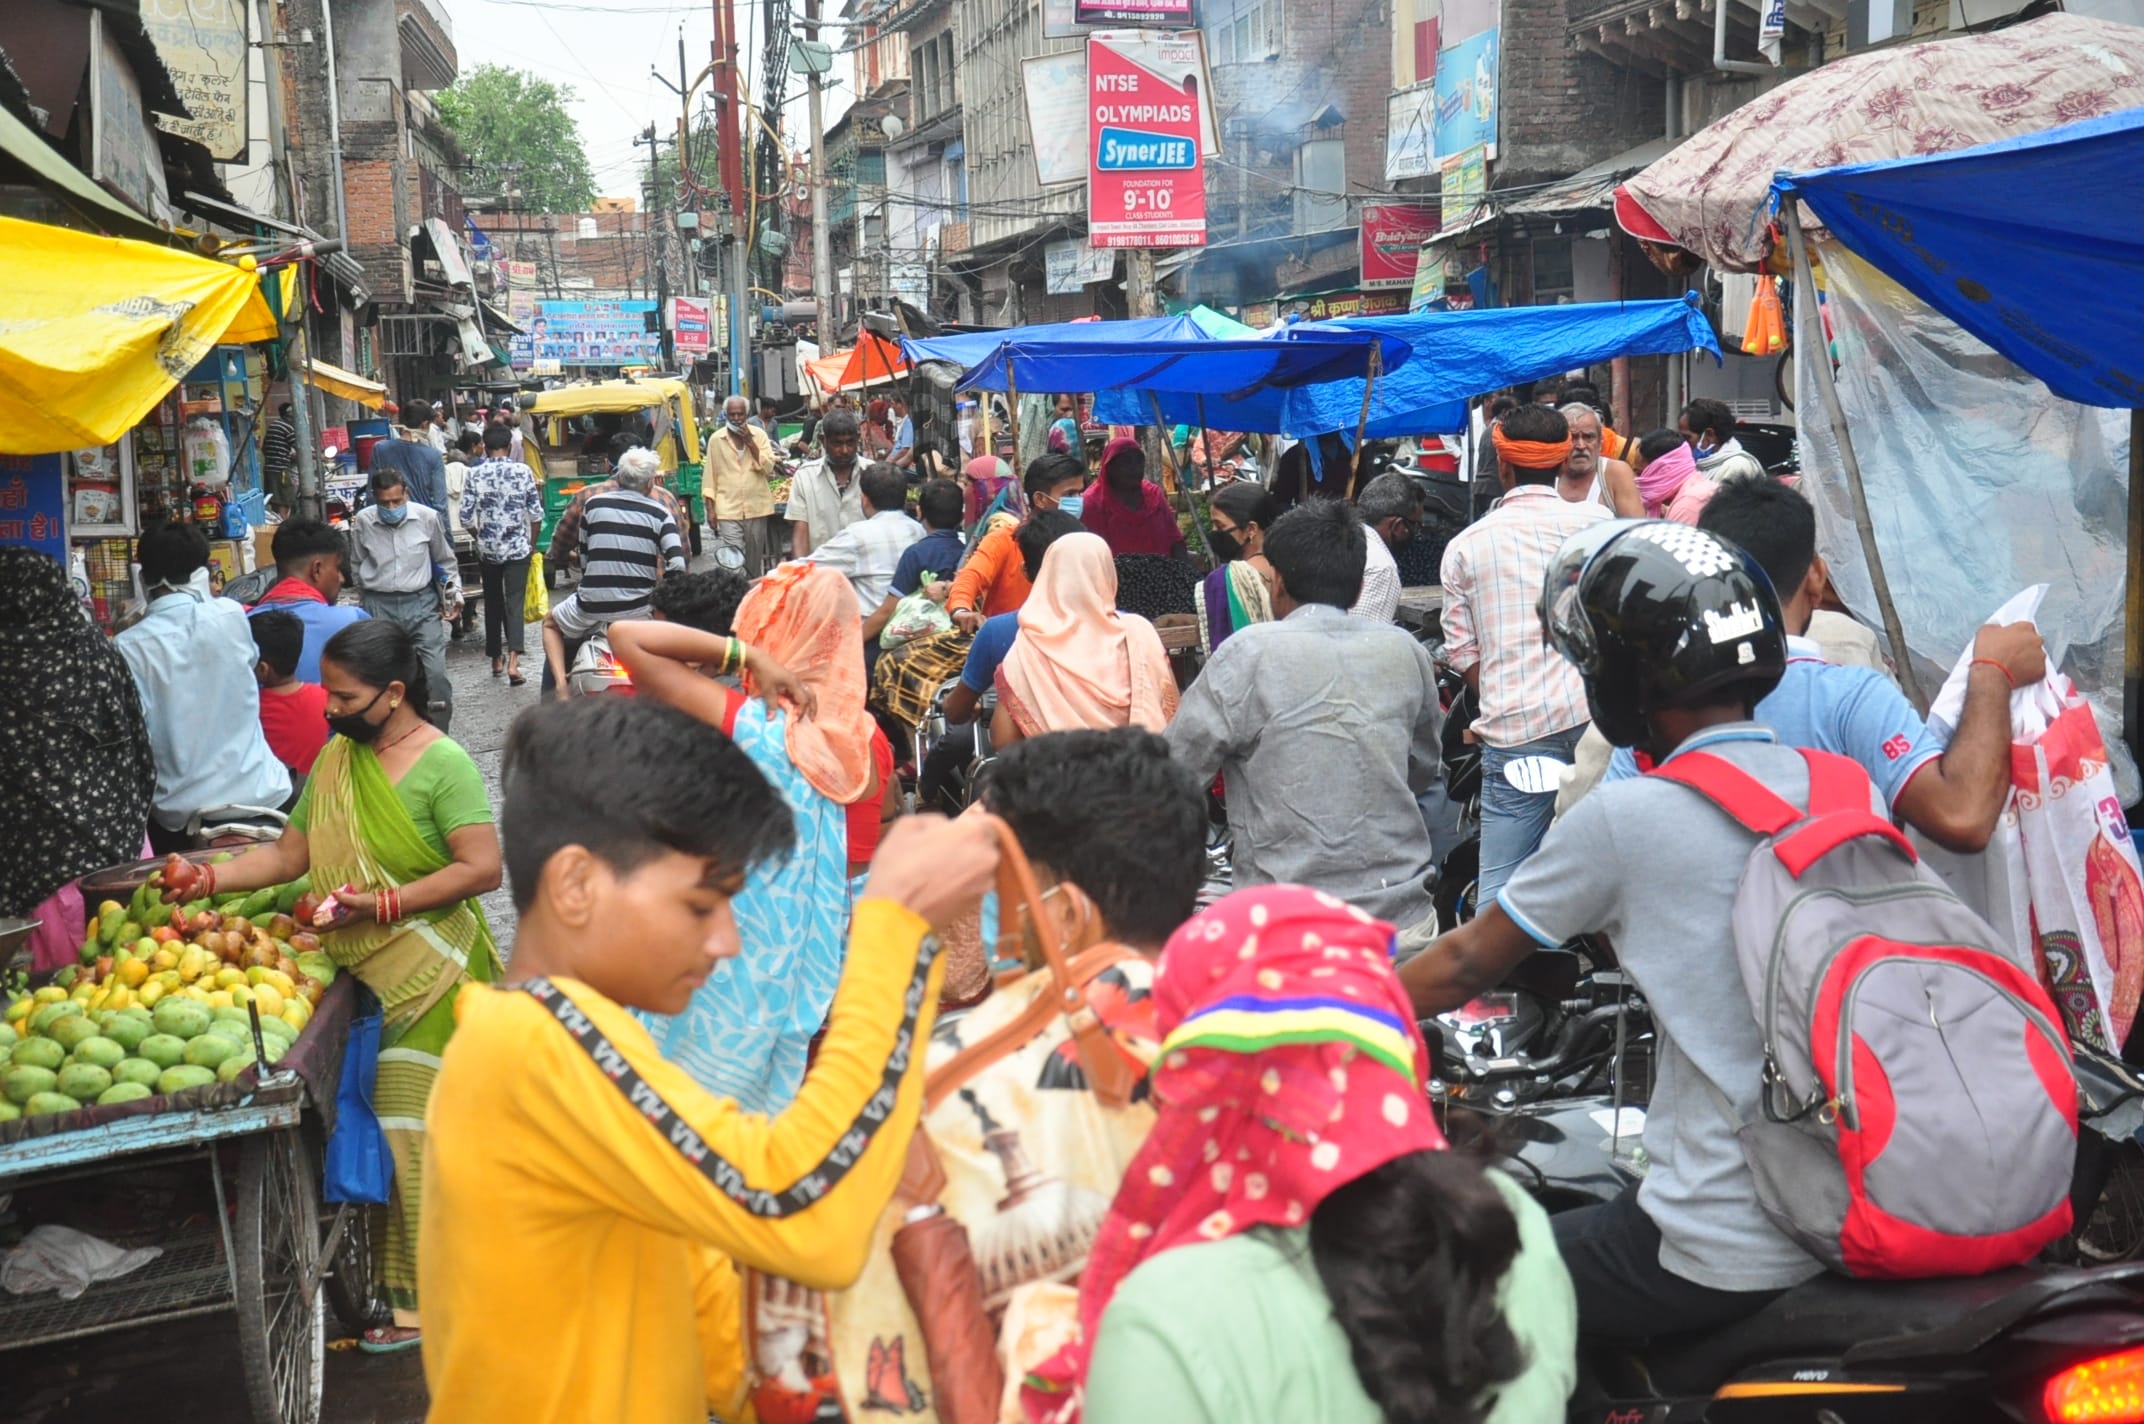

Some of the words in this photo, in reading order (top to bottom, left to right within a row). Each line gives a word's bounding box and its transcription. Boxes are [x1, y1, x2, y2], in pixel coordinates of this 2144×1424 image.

[1096, 74, 1138, 92] NTSE
[1096, 105, 1192, 123] OLYMPIADS
[1105, 138, 1186, 167] SynerJEE
[1122, 180, 1161, 188] FOUNDATION
[1162, 179, 1174, 187] FOR
[1125, 212, 1143, 220] CLASS
[1144, 211, 1174, 219] STUDENTS
[1310, 299, 1326, 317] श्री
[1881, 733, 1912, 761] 85
[1793, 1370, 1829, 1381] Hero
